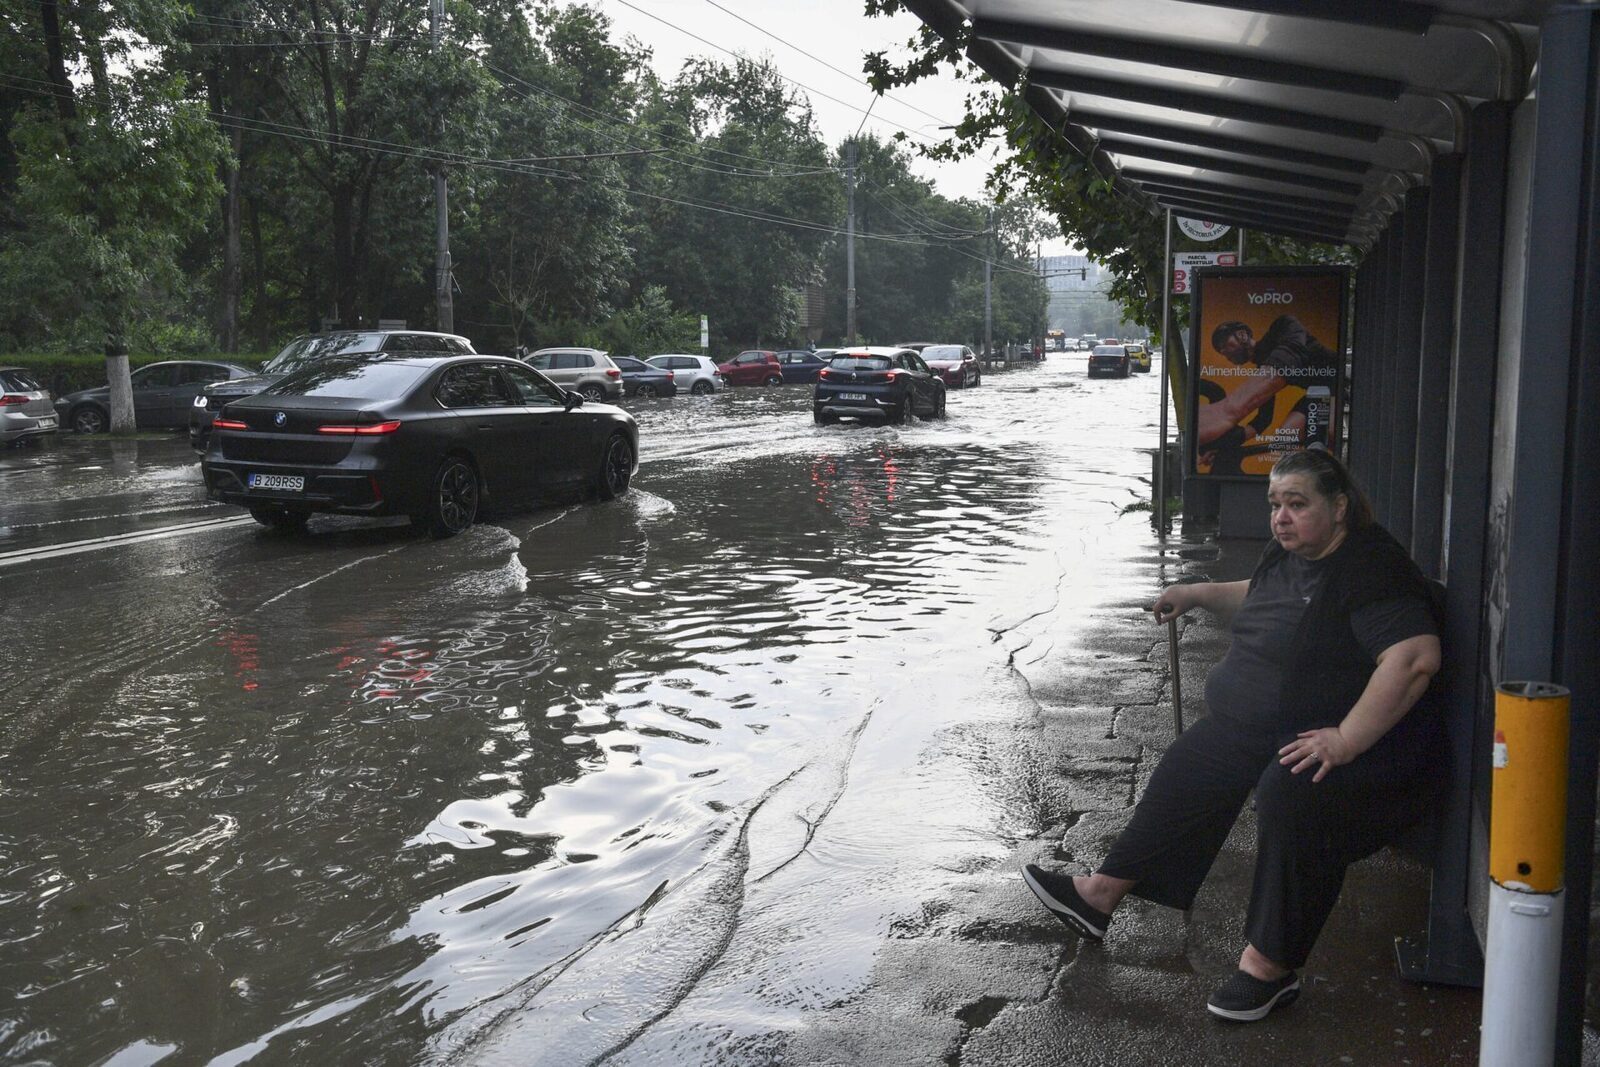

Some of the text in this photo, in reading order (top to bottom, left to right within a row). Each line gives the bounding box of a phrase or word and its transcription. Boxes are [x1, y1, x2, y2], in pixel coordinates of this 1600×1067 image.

[1187, 227, 1213, 238] SECTORUL
[1247, 292, 1293, 304] YoPRO
[1277, 365, 1337, 377] obiectivele
[1307, 402, 1318, 437] YoPRO
